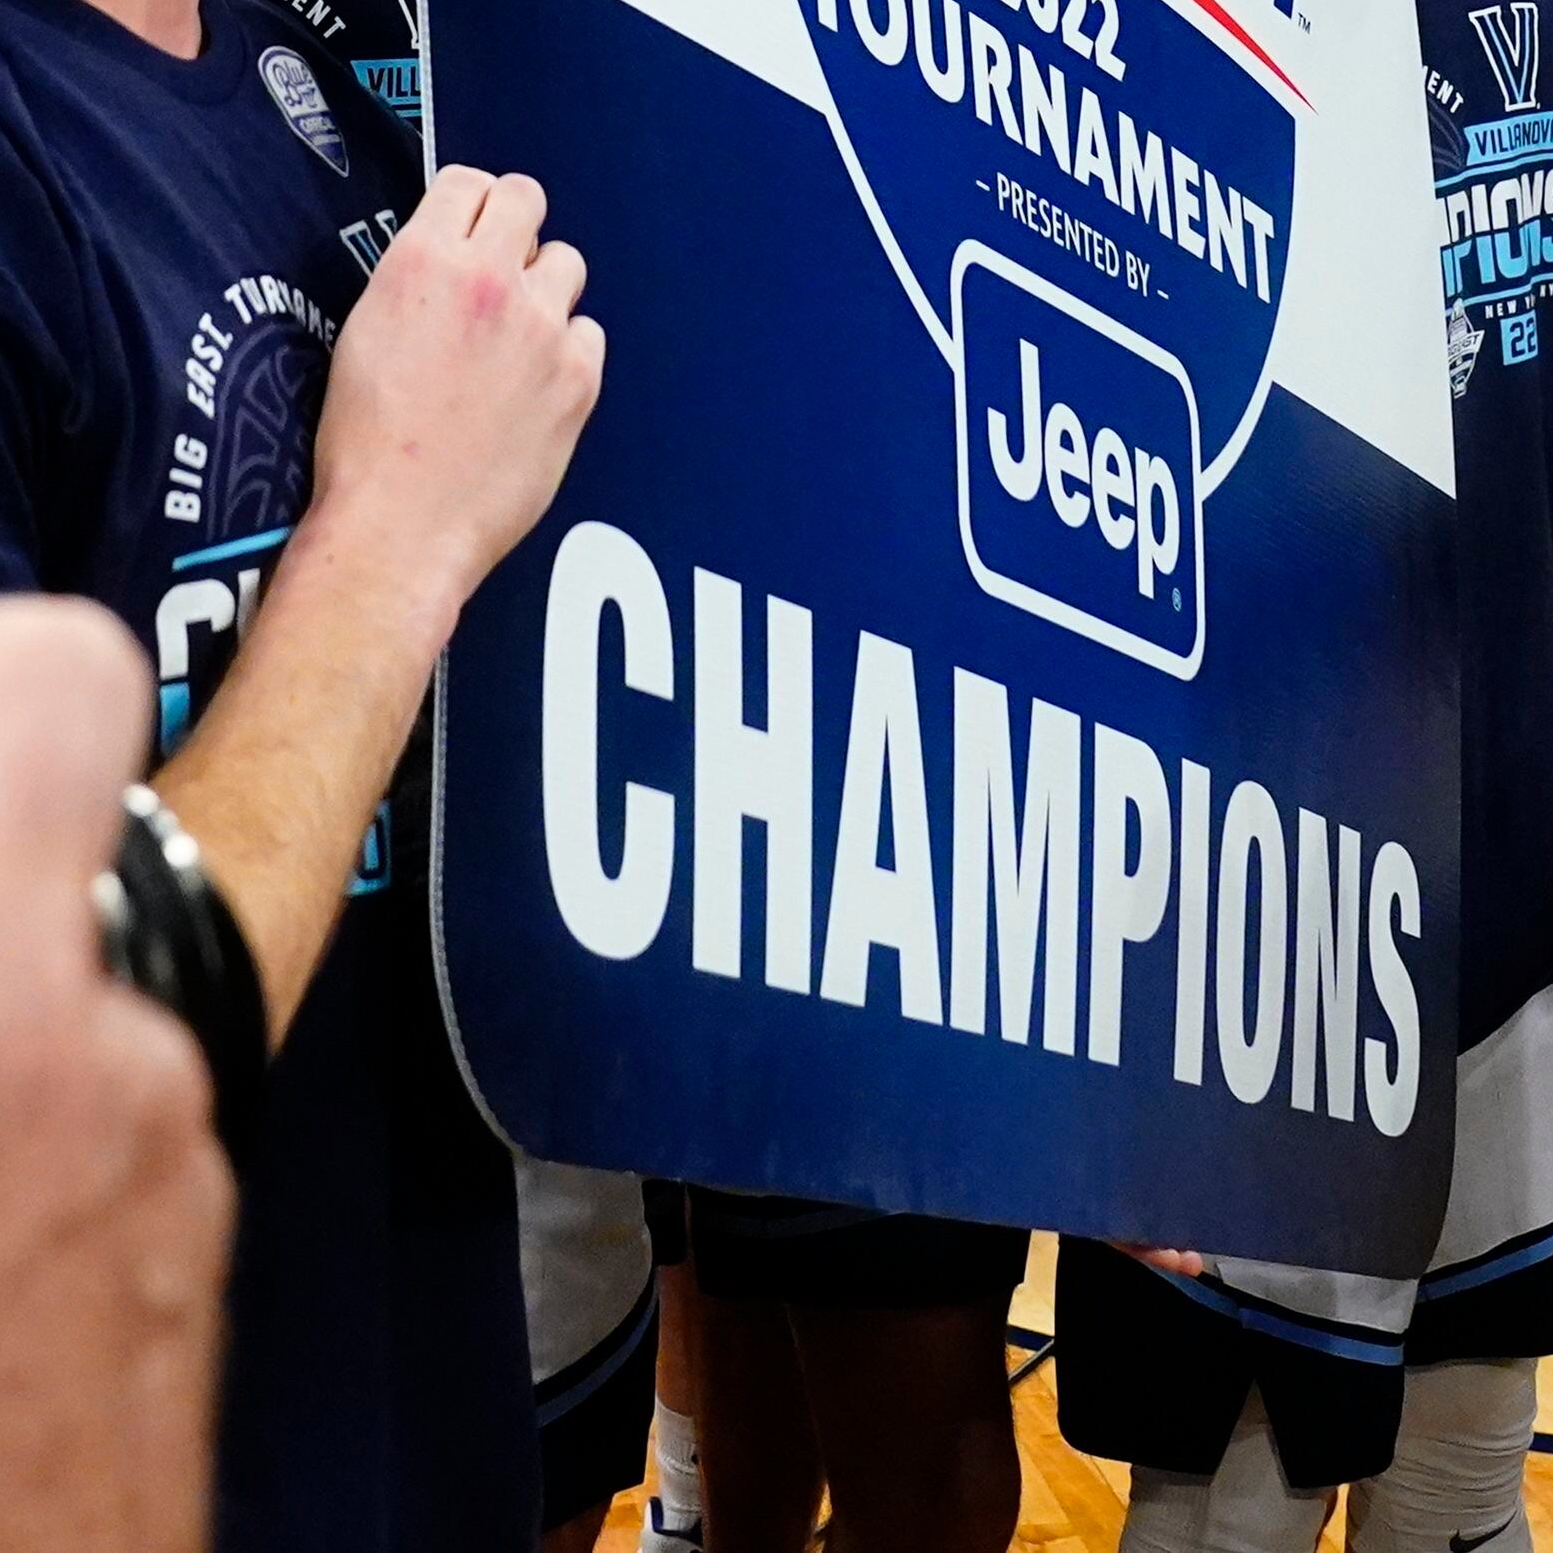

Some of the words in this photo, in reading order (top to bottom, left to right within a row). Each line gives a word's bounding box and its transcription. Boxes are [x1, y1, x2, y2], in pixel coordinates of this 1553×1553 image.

[1469, 3, 1540, 113] V
[996, 171, 1121, 279] PRESENTED
[1125, 254, 1152, 296] BY
[1485, 300, 1517, 320] NEW
[1509, 317, 1537, 359] 22
[186, 313, 234, 417] EAST
[164, 431, 209, 524] BIG
[986, 338, 1180, 599] Jeep
[540, 519, 1423, 1138] CHAMPIONS
